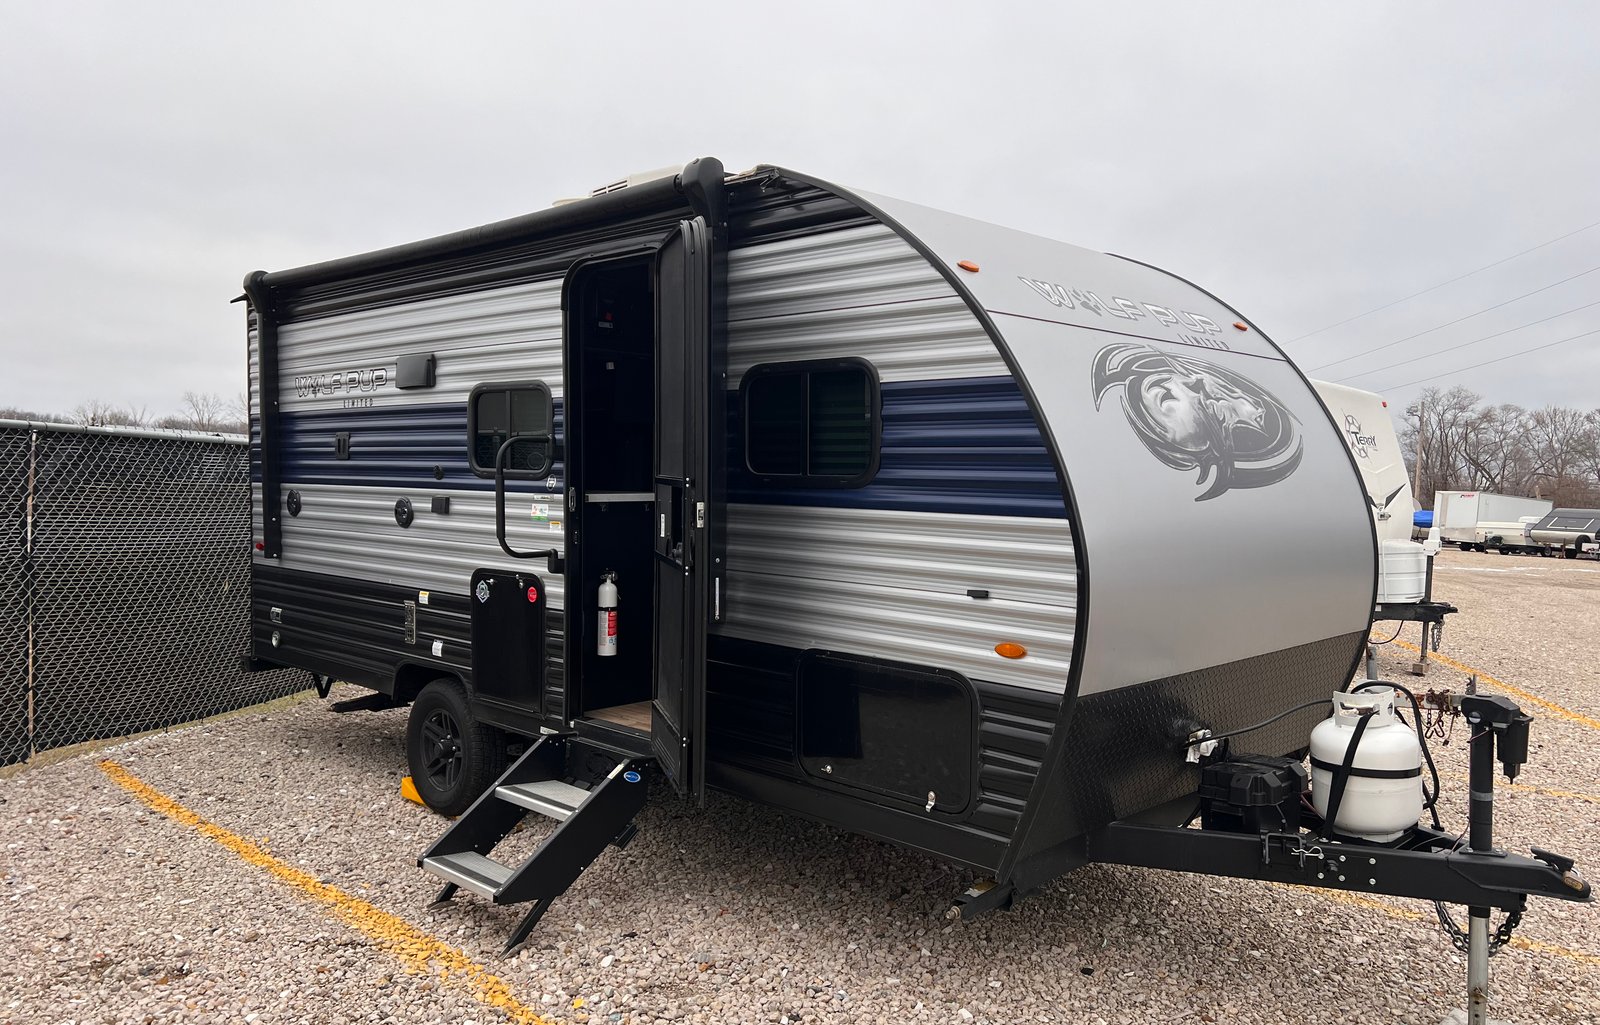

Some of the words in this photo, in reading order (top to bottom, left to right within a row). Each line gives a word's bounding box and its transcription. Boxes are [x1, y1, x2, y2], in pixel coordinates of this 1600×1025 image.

[1141, 302, 1223, 336] PUP
[1177, 333, 1230, 350] LIMITED
[346, 368, 388, 394] PUP
[343, 398, 374, 409] LIMITED
